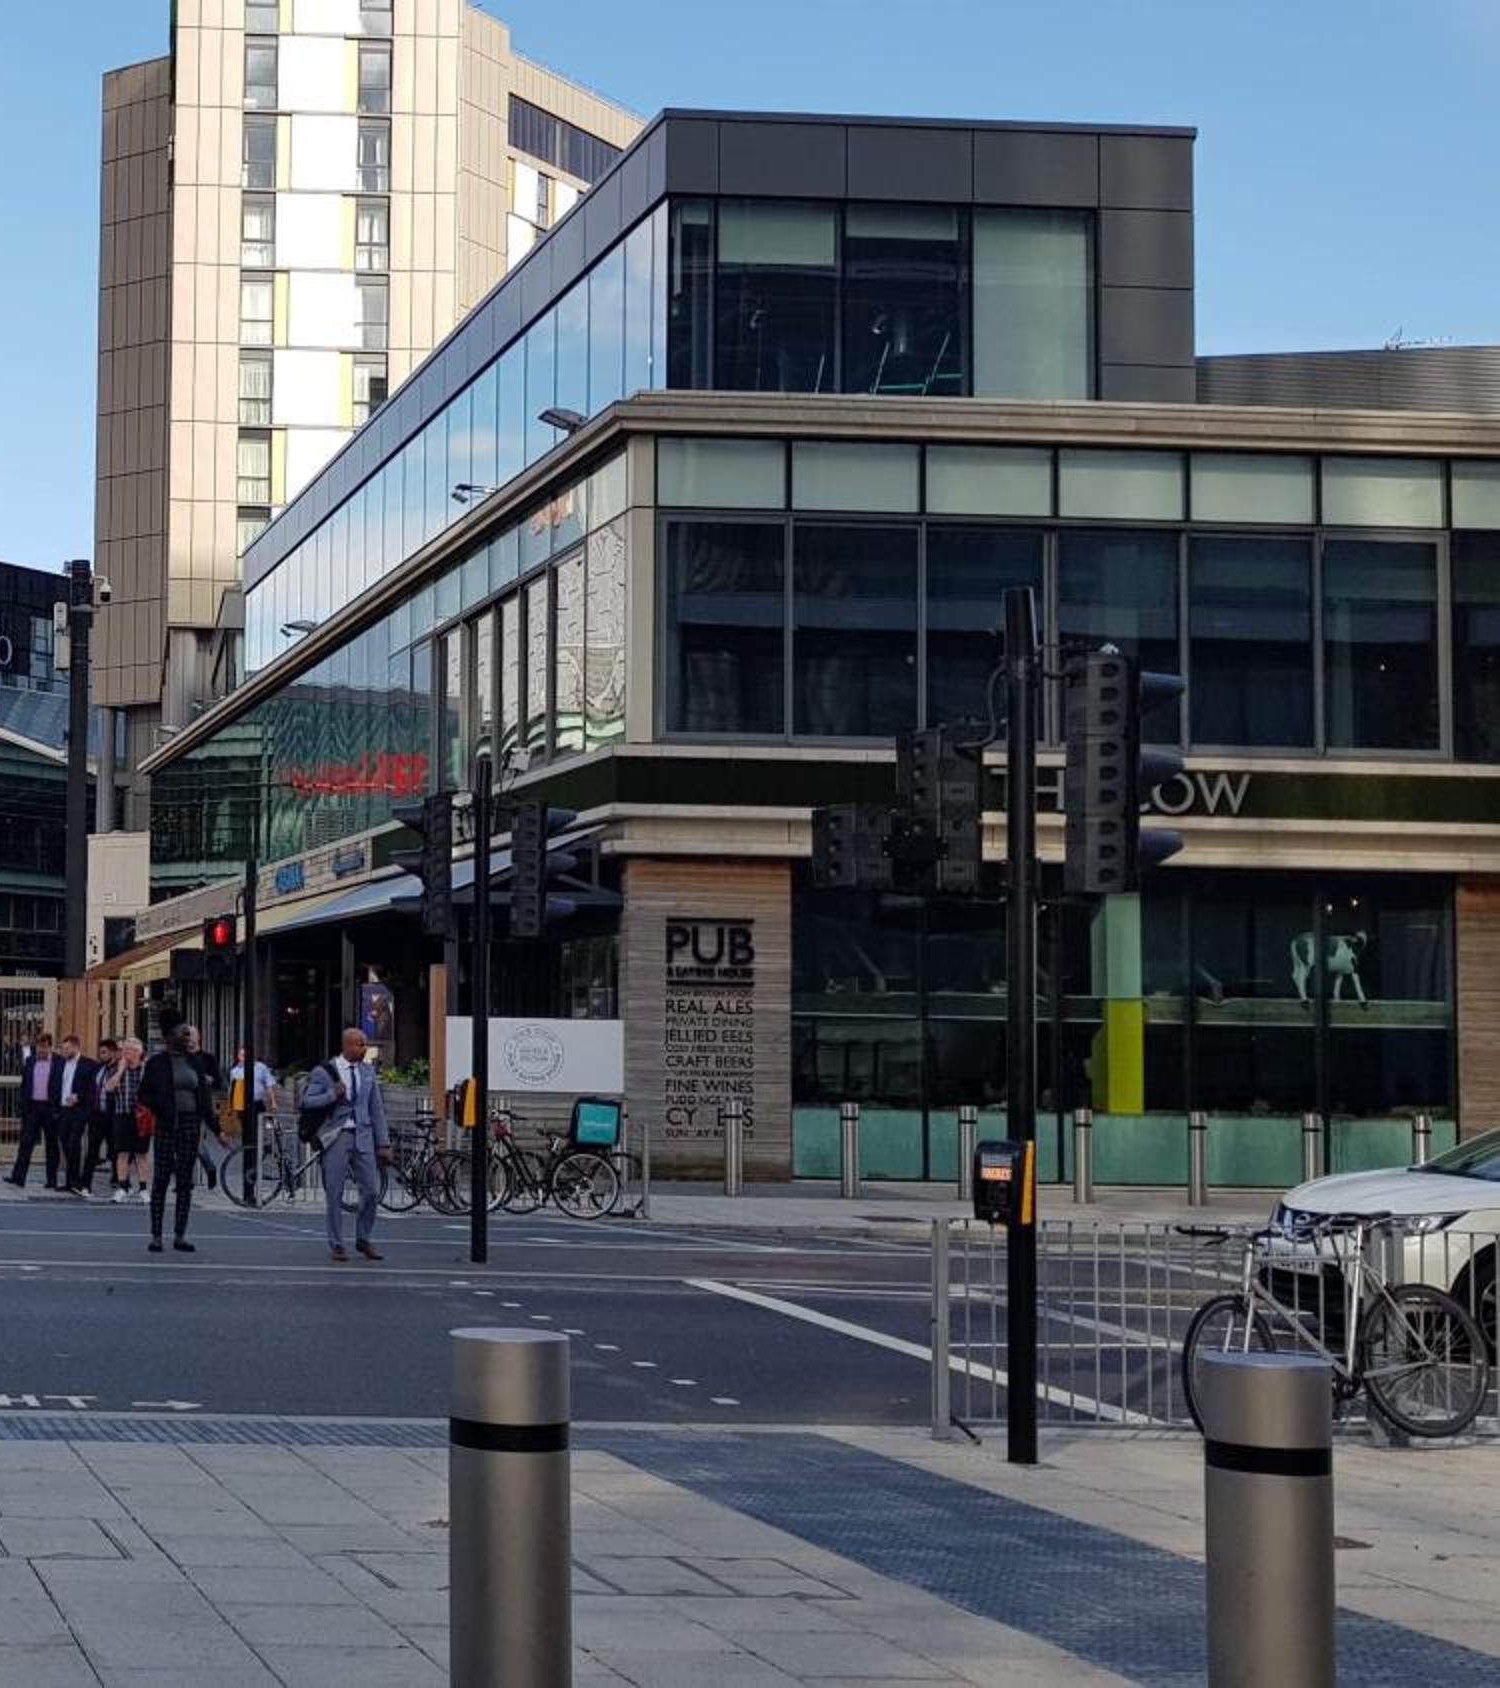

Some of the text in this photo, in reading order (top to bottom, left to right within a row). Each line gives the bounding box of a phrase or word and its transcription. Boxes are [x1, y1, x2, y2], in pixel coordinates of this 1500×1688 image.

[666, 926, 755, 966] PUB
[665, 999, 754, 1014] REAL ALES
[664, 1029, 754, 1044] JELLIED EELS
[665, 1055, 754, 1069] CRAFT BEERS
[665, 1079, 754, 1094] FINE WINES
